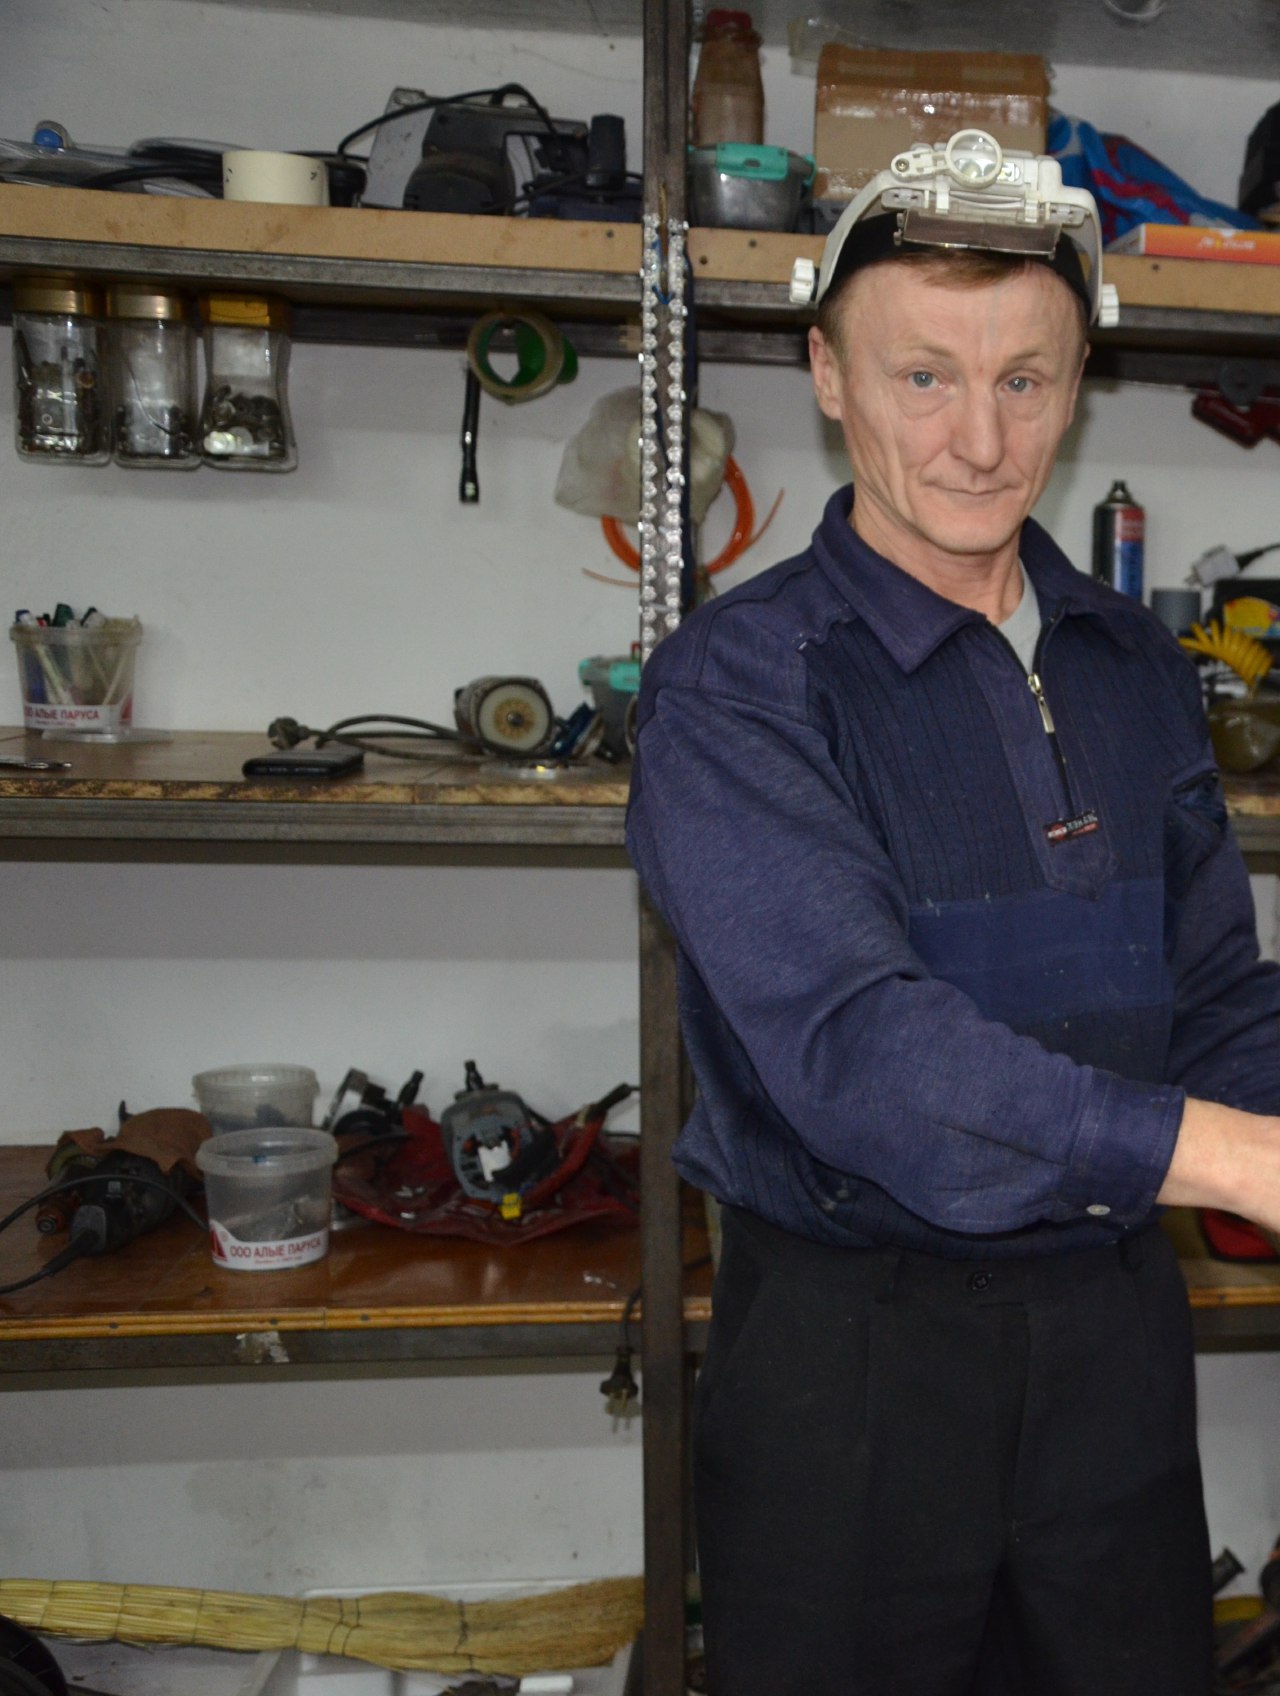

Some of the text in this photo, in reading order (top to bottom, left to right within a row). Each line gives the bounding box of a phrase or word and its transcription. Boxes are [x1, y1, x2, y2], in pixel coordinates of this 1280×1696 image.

[60, 708, 100, 721] ПАРУСА
[229, 1237, 322, 1258] ООО АЛЫЕ ПАРУСА
